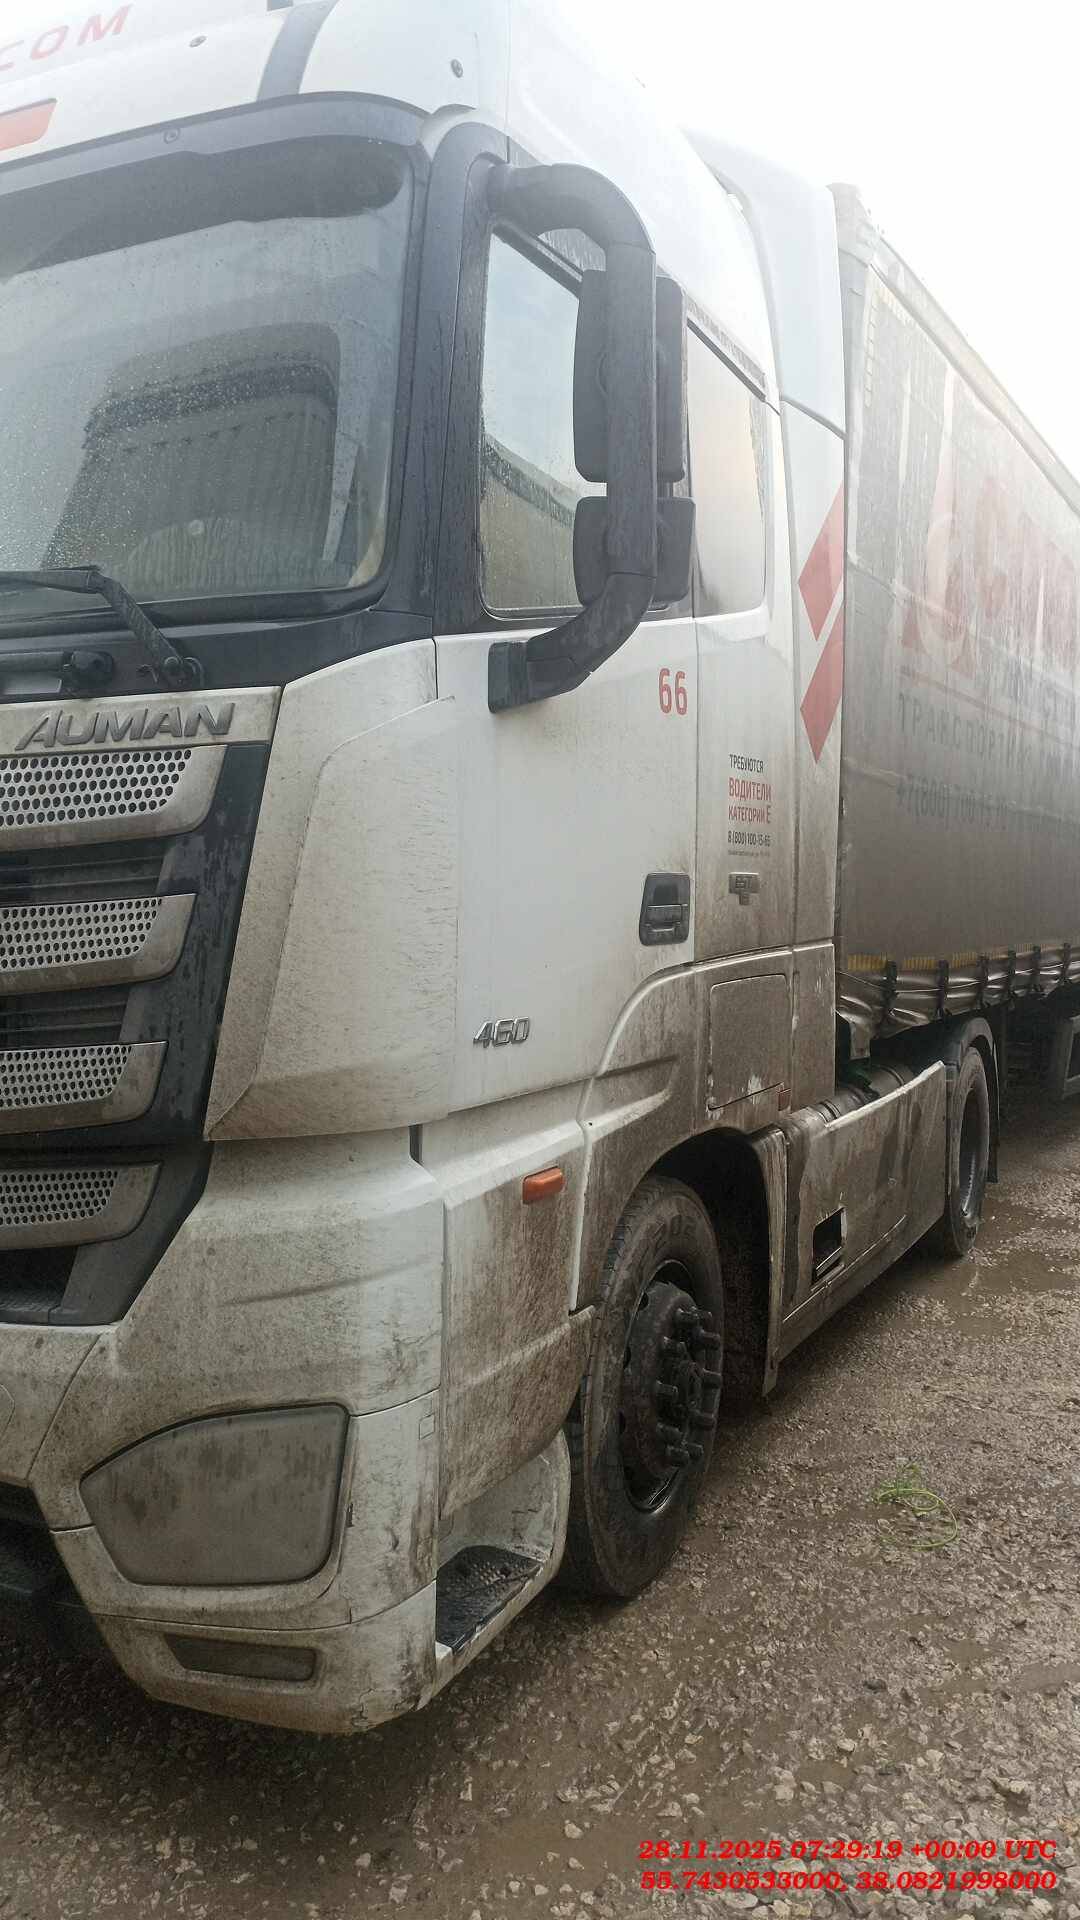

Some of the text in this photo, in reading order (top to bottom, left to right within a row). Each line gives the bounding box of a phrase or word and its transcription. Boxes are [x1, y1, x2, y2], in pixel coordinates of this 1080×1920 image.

[658, 667, 688, 716] 66
[14, 702, 236, 751] AUMAN
[729, 753, 764, 773] ТРЕБУЮТСЯ
[728, 776, 772, 801] ВОДИТЕЛИ
[728, 804, 765, 825] КАТЕГОРИИ
[473, 1015, 530, 1049] 460
